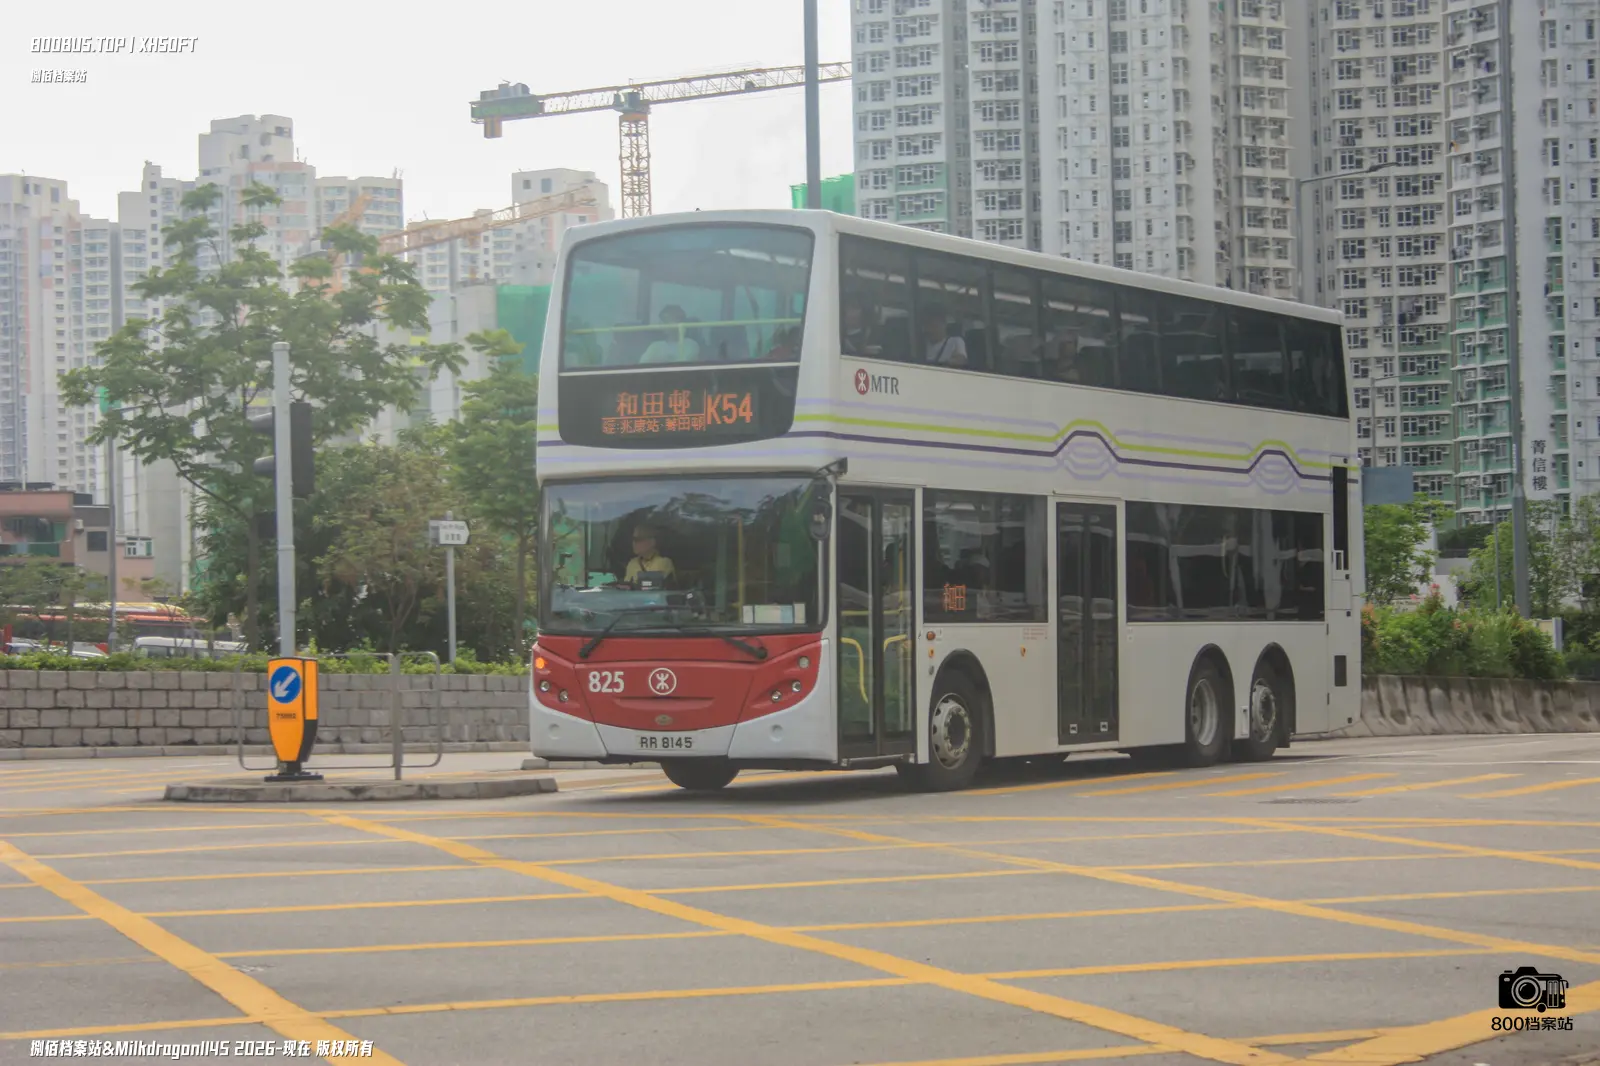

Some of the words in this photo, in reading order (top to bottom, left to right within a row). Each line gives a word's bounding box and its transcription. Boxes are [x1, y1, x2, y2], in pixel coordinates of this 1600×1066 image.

[871, 374, 900, 395] MTR
[616, 389, 692, 416] 和田邨
[706, 392, 753, 425] K54
[588, 671, 625, 693] 825
[640, 736, 658, 749] RR
[661, 736, 693, 749] 8145
